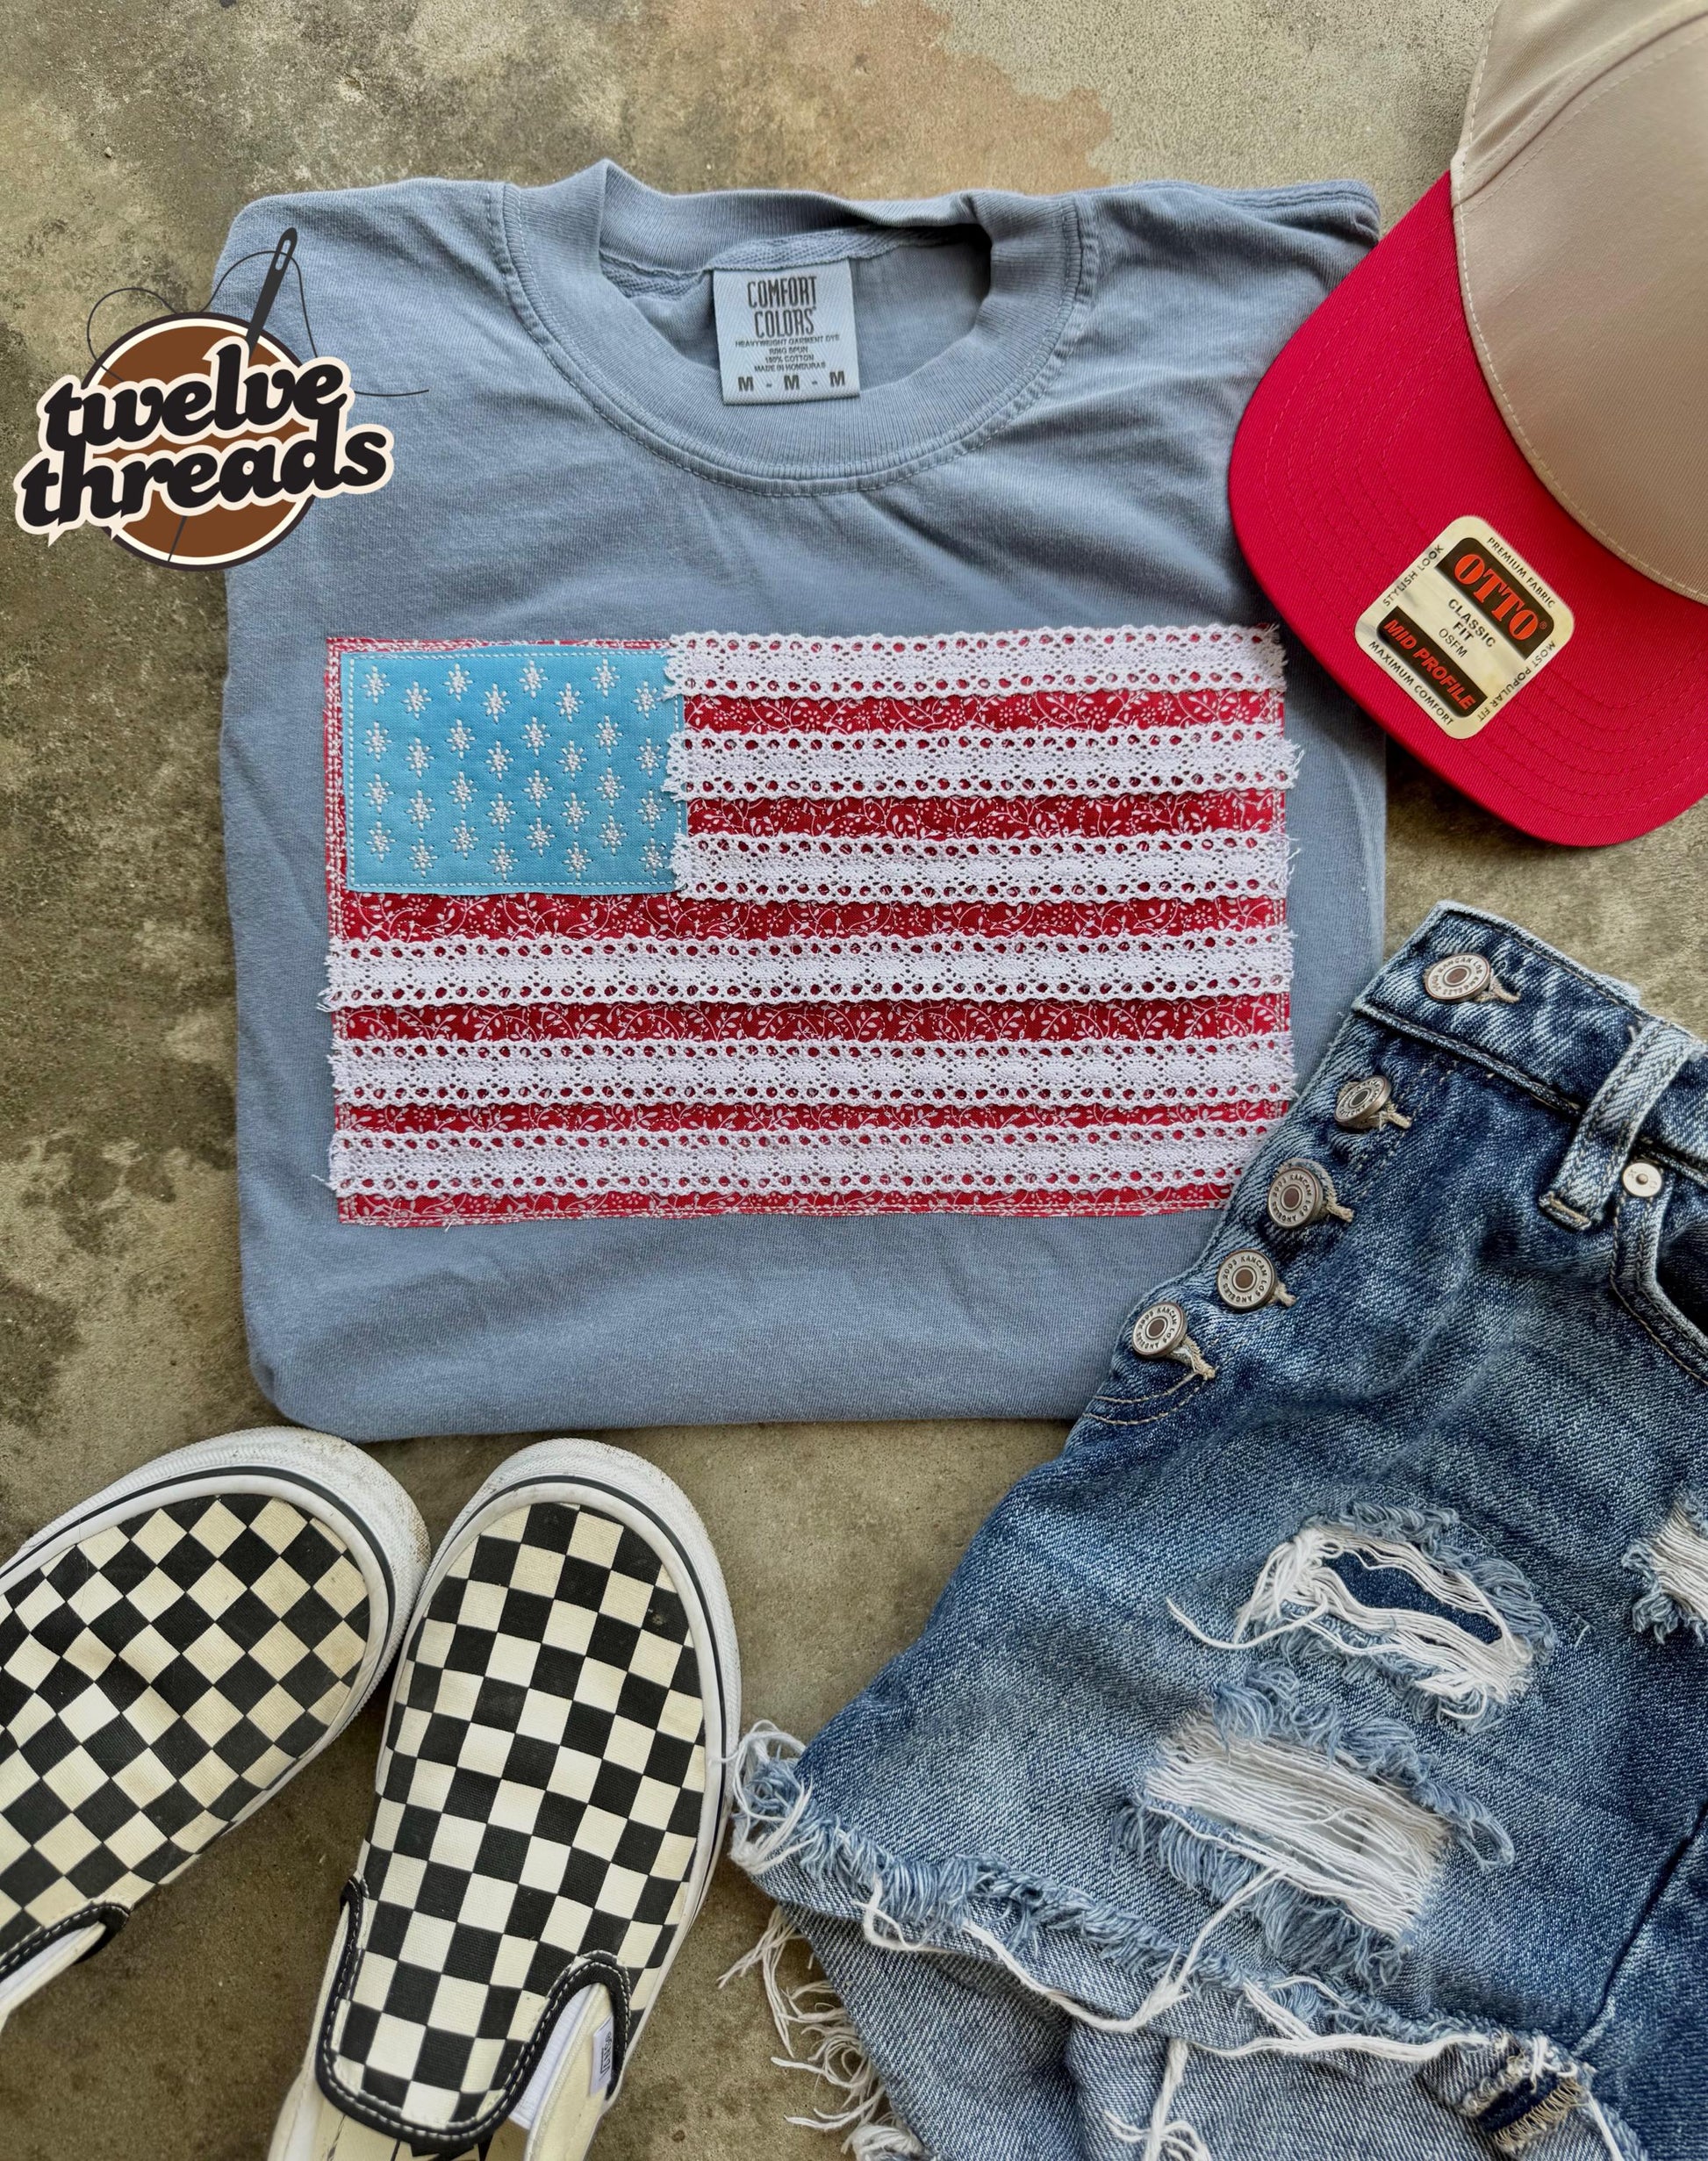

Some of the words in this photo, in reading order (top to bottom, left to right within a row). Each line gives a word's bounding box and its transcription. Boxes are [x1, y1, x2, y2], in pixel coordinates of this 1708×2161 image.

[747, 276, 817, 308] COMFORT
[754, 308, 815, 338] COLORS
[735, 339, 787, 348] HEAVYWEIGHT
[788, 336, 823, 346] GARMENT
[737, 376, 755, 392] M
[784, 374, 800, 391] M
[829, 370, 845, 387] M
[786, 362, 826, 370] HONDURAS
[1382, 571, 1418, 607] STYLISH
[1417, 544, 1444, 571] LOOK
[1486, 536, 1527, 578] PREMIUM
[1525, 576, 1556, 608] FABRIC
[1453, 553, 1539, 642] OTTO
[1448, 598, 1496, 648] CLASSIC
[1453, 622, 1475, 643] FIT
[1438, 627, 1468, 658] OSFM
[1531, 640, 1557, 668] MOST
[1383, 618, 1417, 650] MID
[1412, 647, 1476, 710] PROFILE
[1367, 640, 1415, 686] MAXIMUM
[1414, 684, 1454, 726] COMFORT
[1489, 666, 1532, 708] POPULAR
[1476, 705, 1491, 722] FIT
[1240, 1255, 1267, 1276] KANCAN
